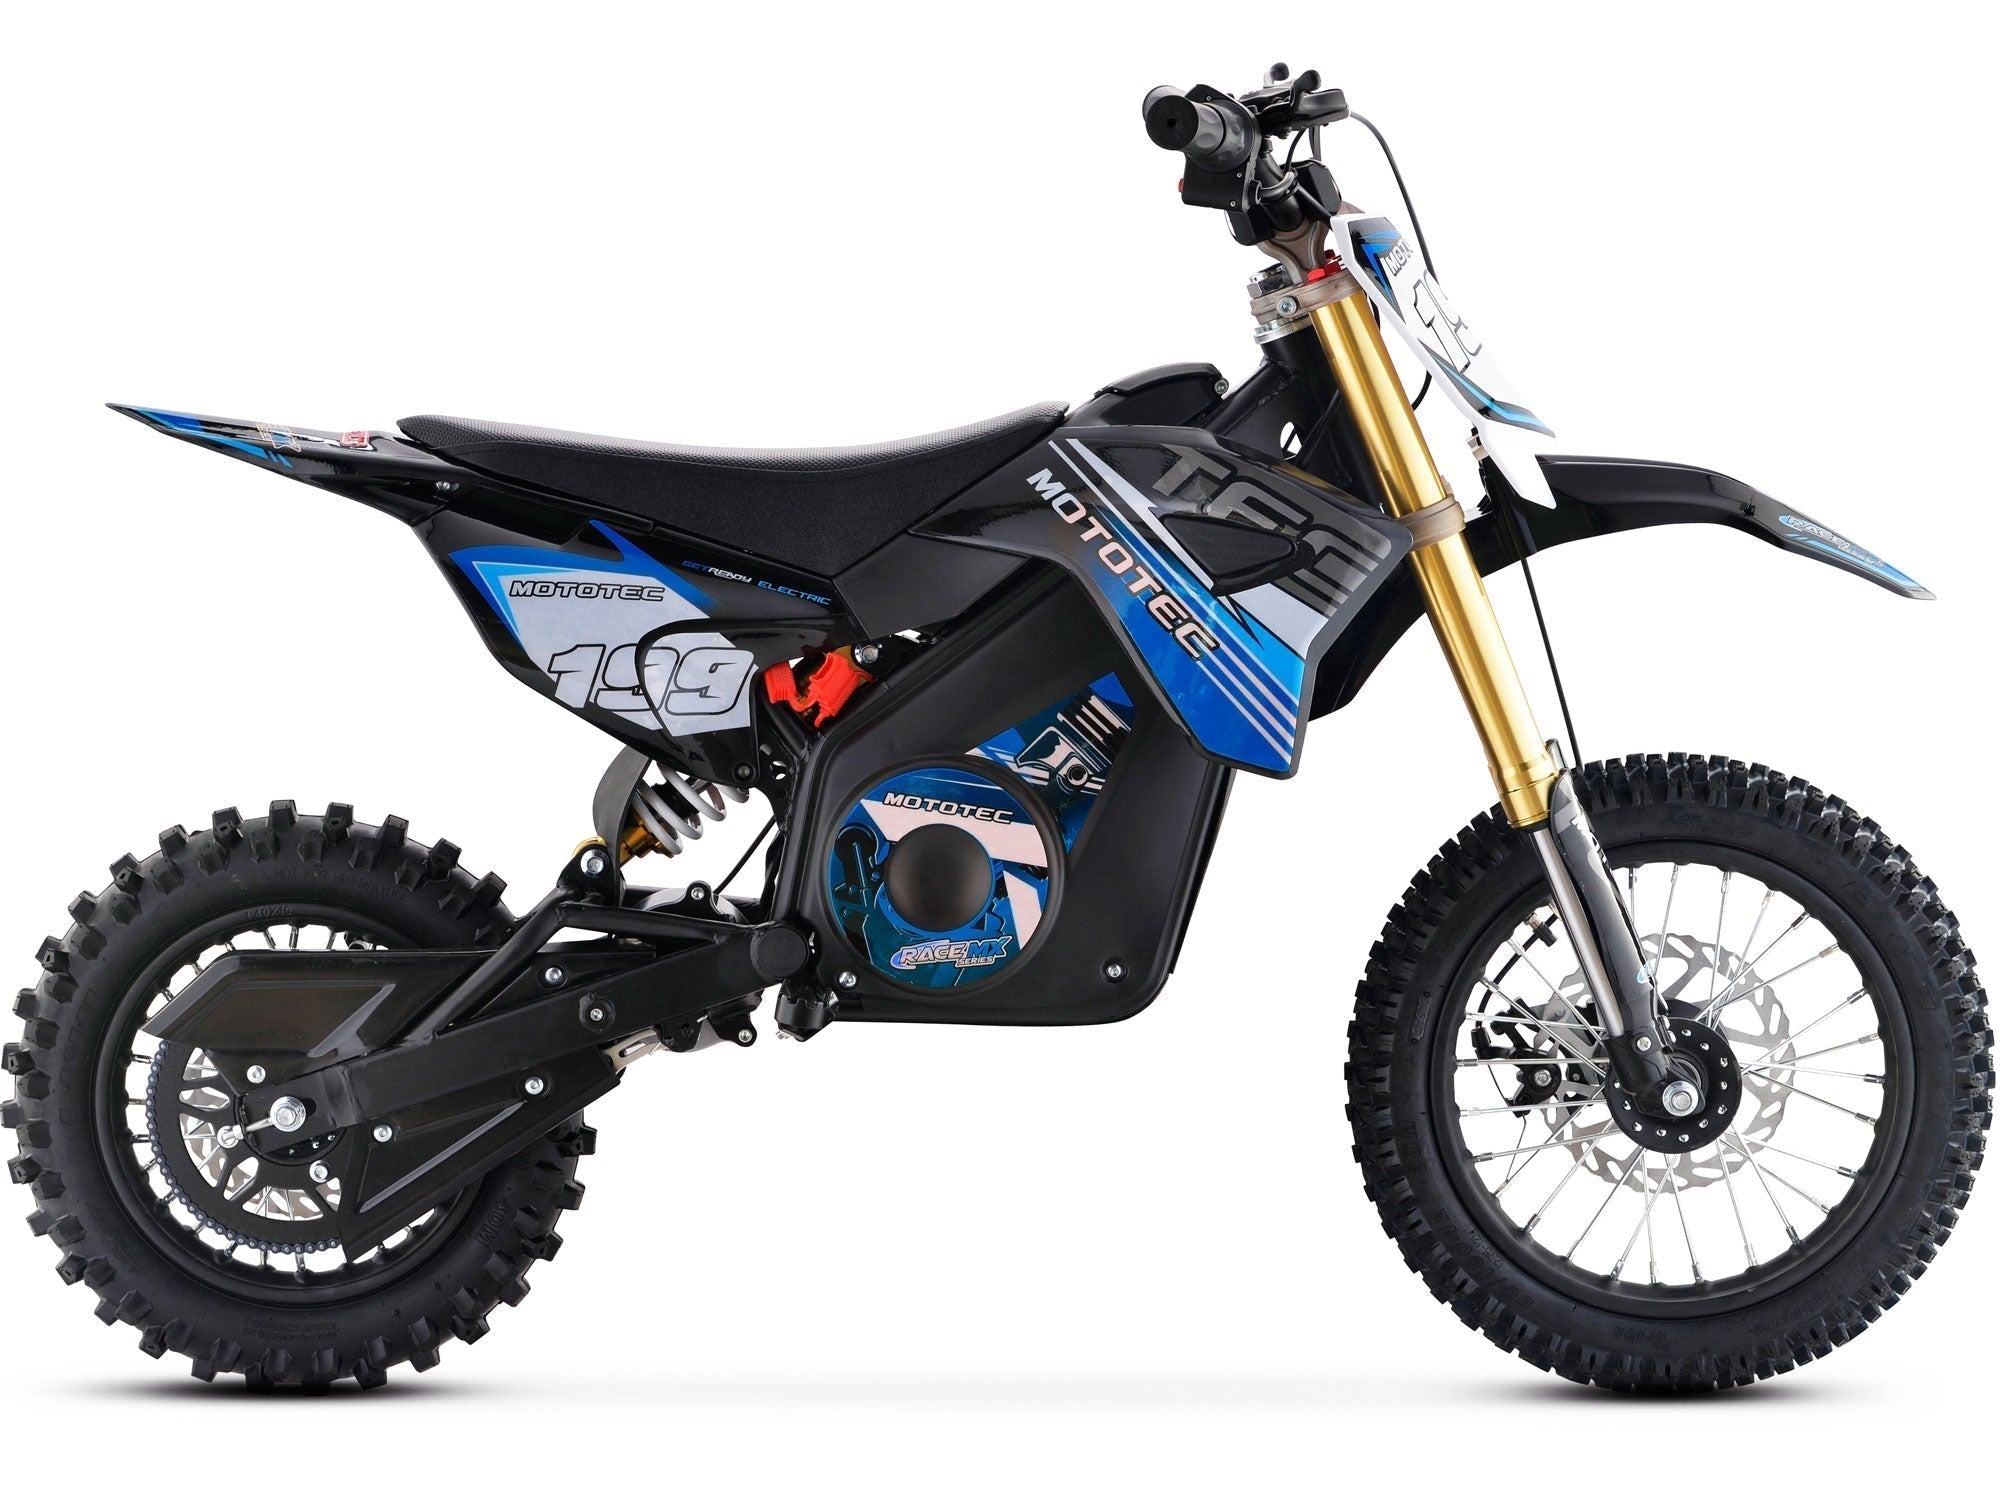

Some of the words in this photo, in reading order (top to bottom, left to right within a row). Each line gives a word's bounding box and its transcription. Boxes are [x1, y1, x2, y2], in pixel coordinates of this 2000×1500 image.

[1026, 468, 1220, 661] MOTOTEC
[509, 581, 665, 602] MOTOTEC
[758, 580, 831, 605] ELECTRIC
[548, 644, 754, 716] 199
[882, 791, 1013, 824] MOTOTEC
[957, 956, 995, 967] SERIES
